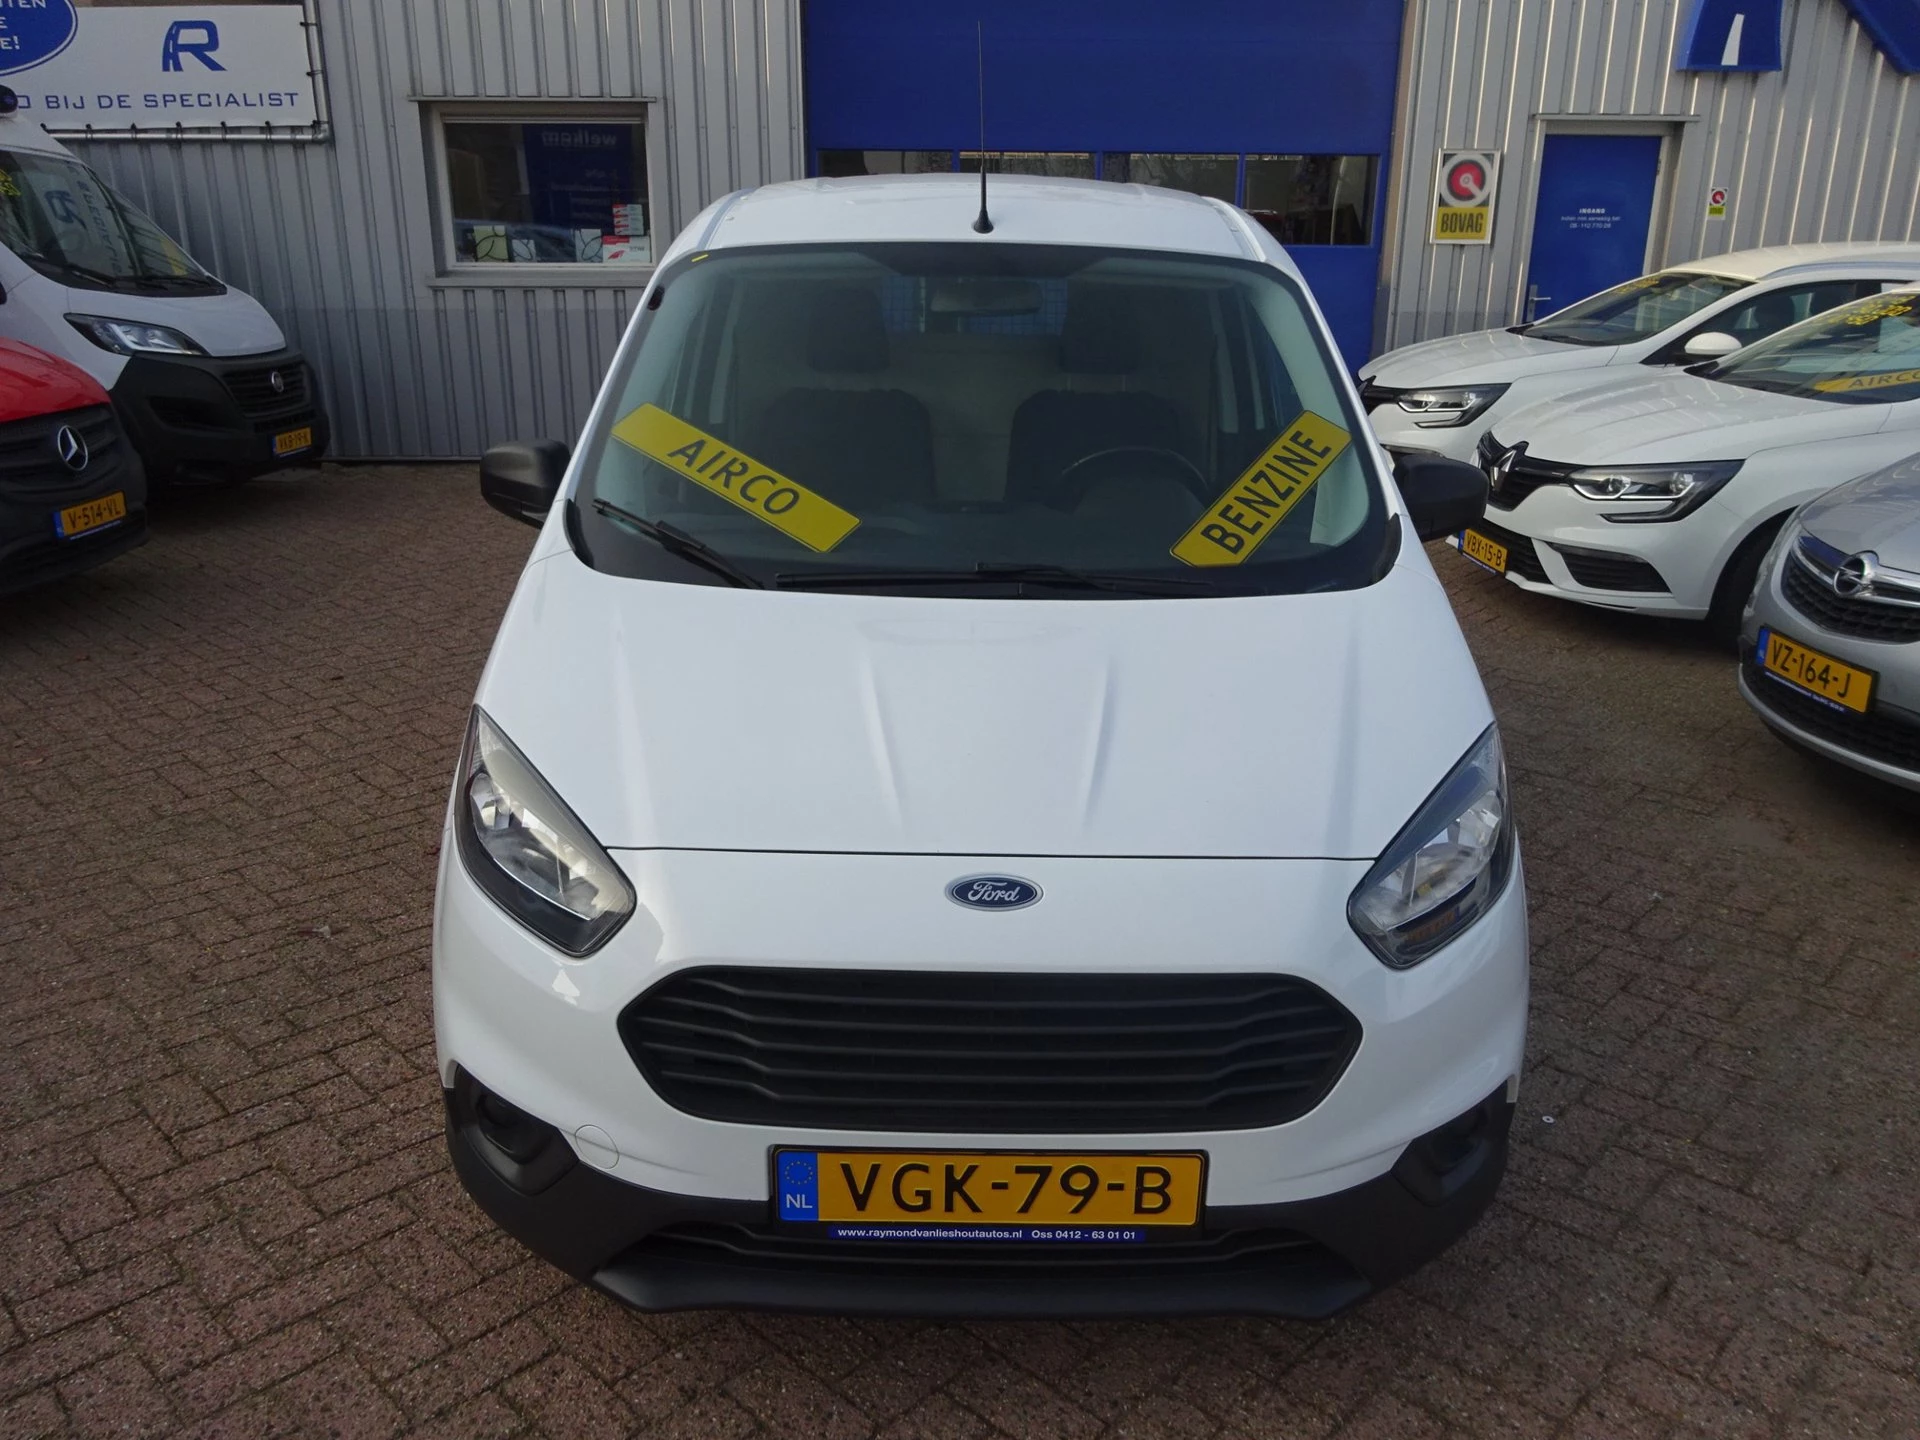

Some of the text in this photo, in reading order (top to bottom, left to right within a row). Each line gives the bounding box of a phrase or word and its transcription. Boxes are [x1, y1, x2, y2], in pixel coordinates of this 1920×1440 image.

[45, 95, 85, 109] BIJ
[97, 94, 131, 109] DE
[144, 92, 299, 108] SPECIALIST
[1441, 212, 1483, 233] BOVAG
[667, 439, 800, 515] AIRCO
[1201, 430, 1332, 555] BENZINE
[67, 498, 122, 529] V-514-VL
[1467, 532, 1502, 566] VBX-15-B
[1773, 640, 1851, 698] VZ-164-J
[967, 880, 1021, 901] Ford
[786, 1194, 813, 1209] NL
[839, 1162, 1172, 1214] VGK-79-B
[838, 1228, 1022, 1239] www.raymondvanlieshoutautos.nl
[1031, 1230, 1053, 1239] Oss
[1055, 1230, 1081, 1239] 0412
[1091, 1230, 1105, 1239] 63
[1105, 1230, 1120, 1239] 01
[1123, 1231, 1136, 1239] 01
